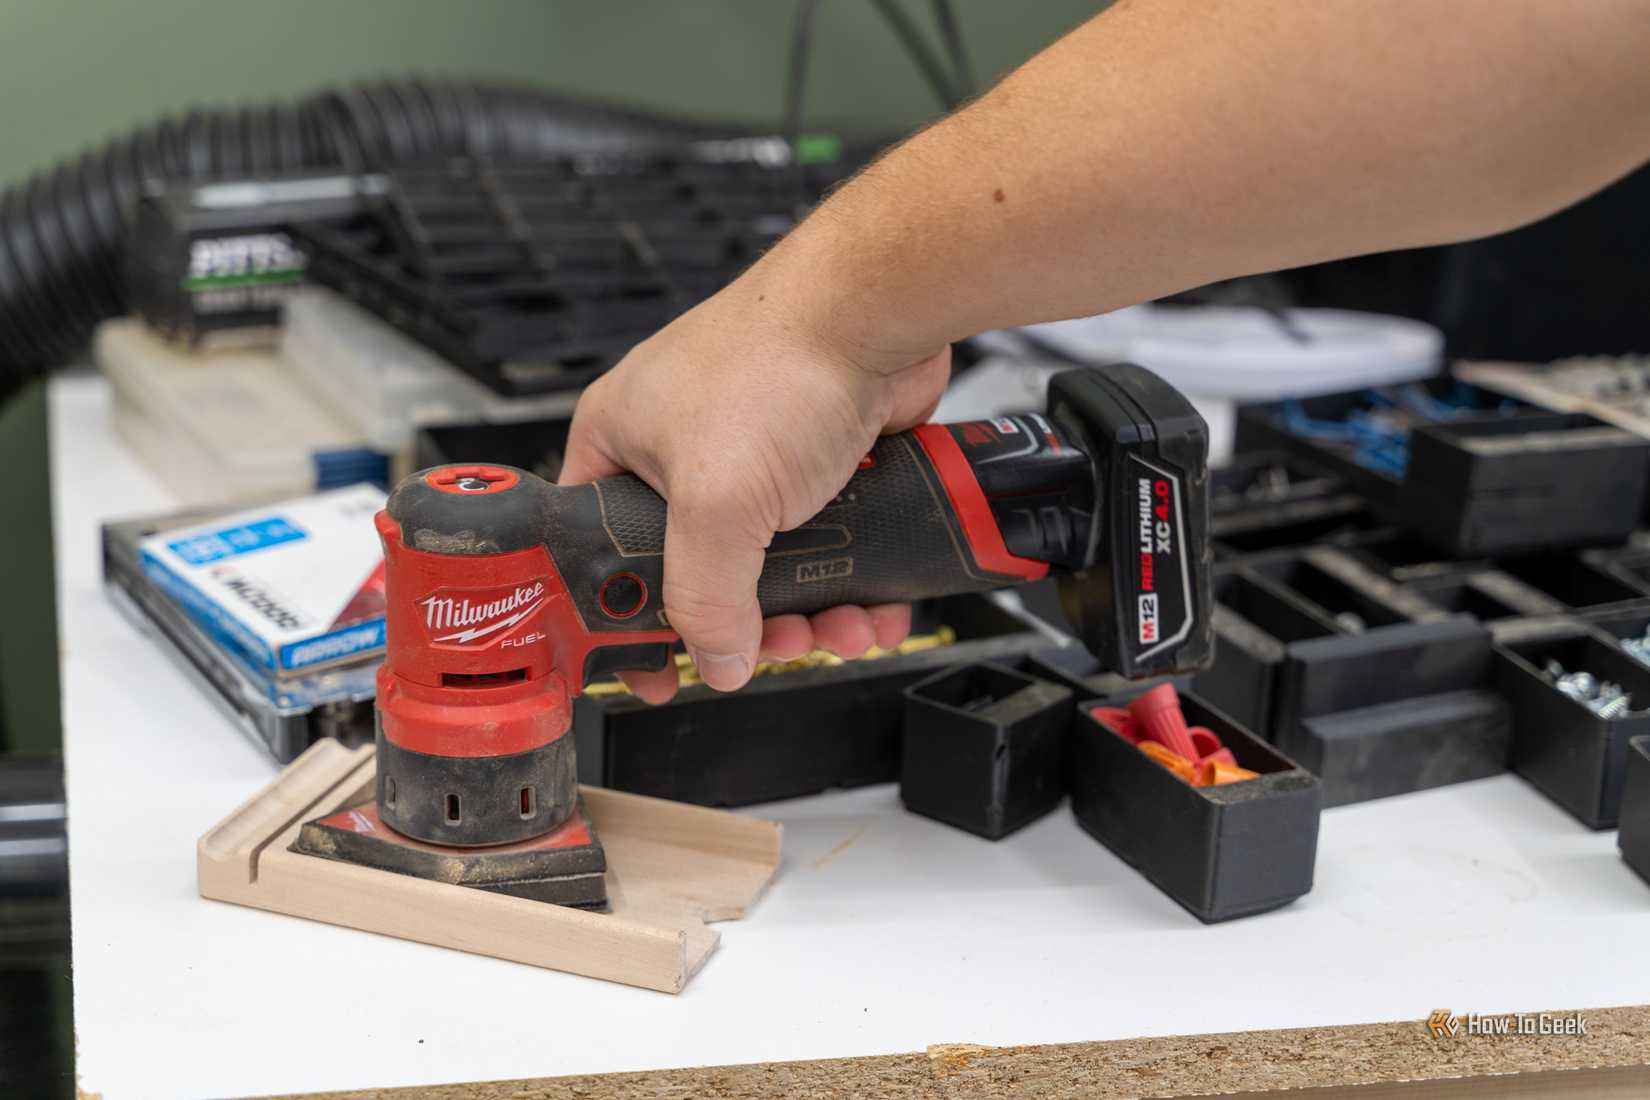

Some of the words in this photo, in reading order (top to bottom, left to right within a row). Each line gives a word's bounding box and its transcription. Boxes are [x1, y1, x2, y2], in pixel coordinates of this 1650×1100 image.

[421, 581, 546, 629] Milwaukee
[1142, 598, 1155, 640] M12
[500, 631, 547, 649] FUEL
